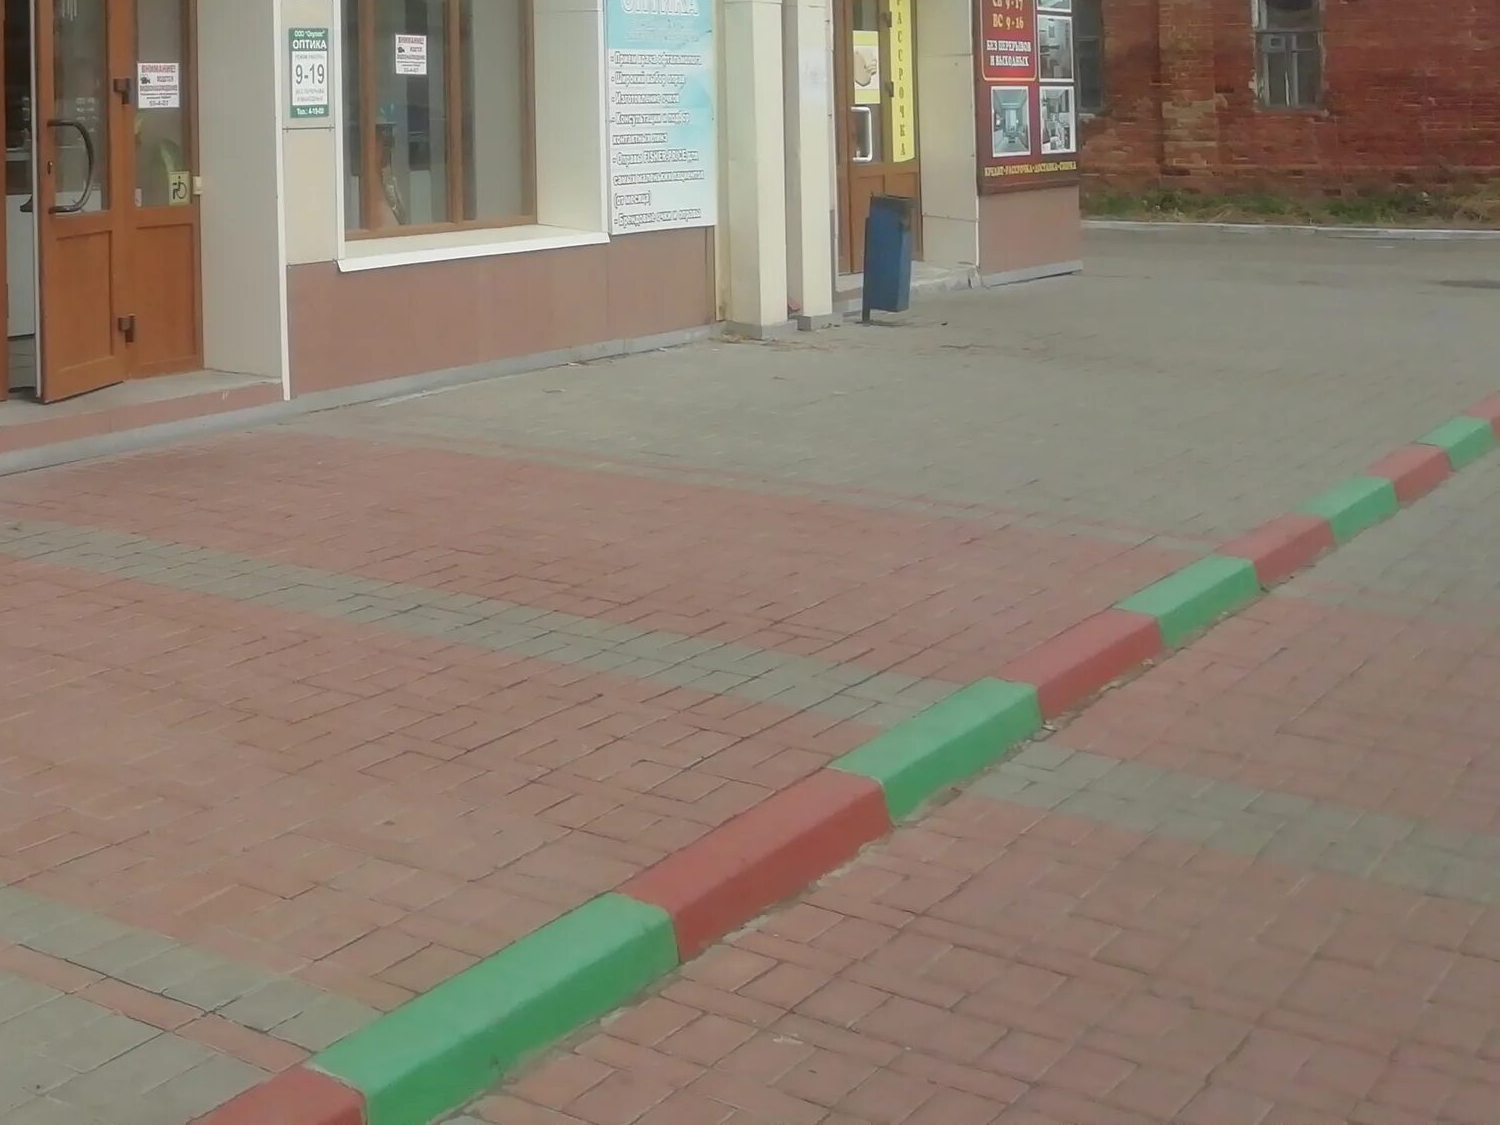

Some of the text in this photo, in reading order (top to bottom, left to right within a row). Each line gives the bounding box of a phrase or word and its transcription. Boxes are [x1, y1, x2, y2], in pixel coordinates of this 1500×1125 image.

[992, 13, 1004, 28] ВС
[292, 39, 327, 49] ОПТИКА
[986, 39, 997, 51] БЕЗ
[995, 55, 1030, 67] ВЫХОДНЫХ
[141, 64, 176, 73] ВНИМАНИЕ!
[295, 63, 325, 85] 9-19
